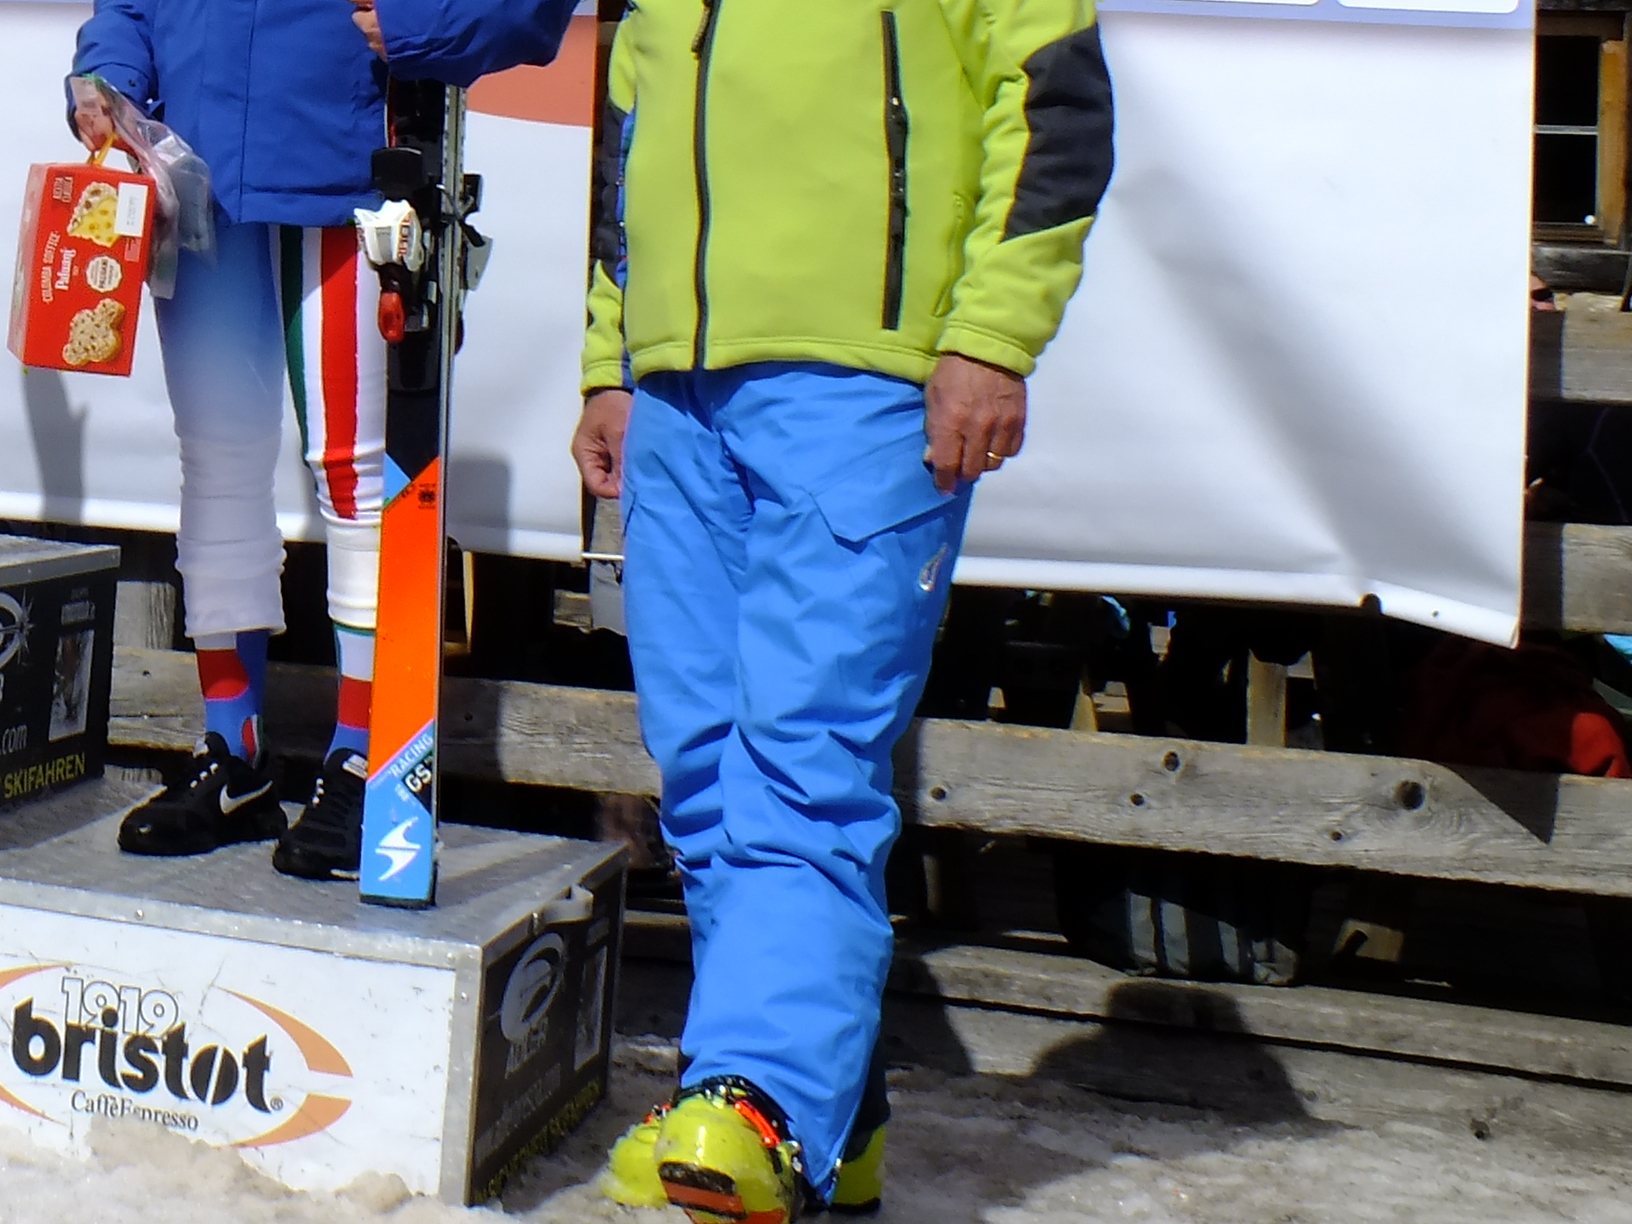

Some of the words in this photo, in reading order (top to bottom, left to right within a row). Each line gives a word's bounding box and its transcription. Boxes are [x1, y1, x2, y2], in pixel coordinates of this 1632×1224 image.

[3, 752, 86, 800] SKIFAHREN
[390, 733, 434, 778] RACING
[405, 763, 432, 793] GS
[61, 976, 179, 1039] 1919
[12, 996, 272, 1114] bristot
